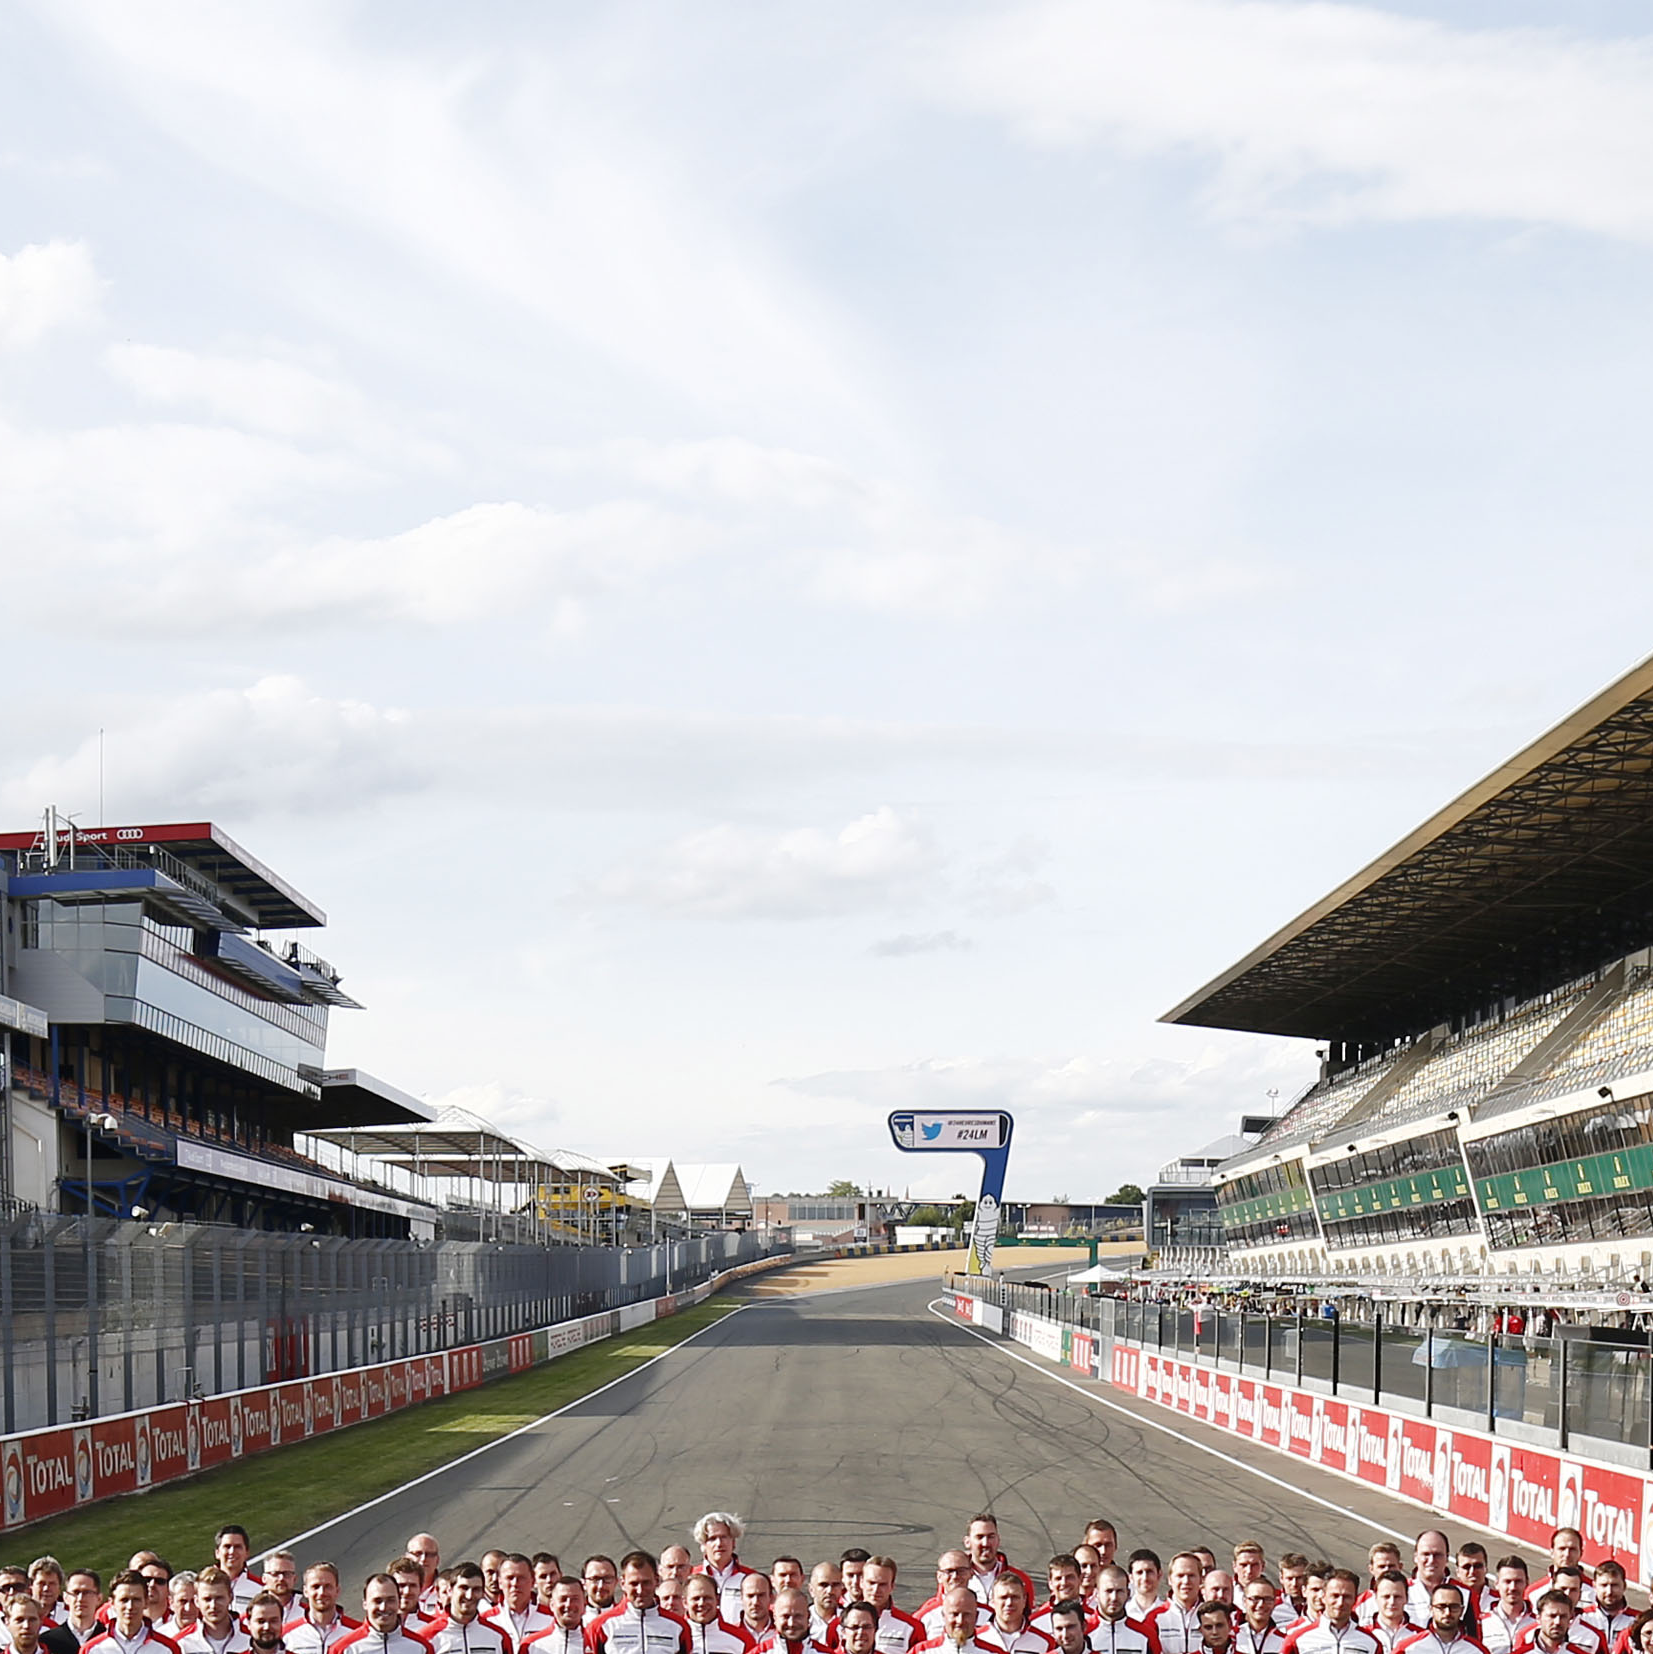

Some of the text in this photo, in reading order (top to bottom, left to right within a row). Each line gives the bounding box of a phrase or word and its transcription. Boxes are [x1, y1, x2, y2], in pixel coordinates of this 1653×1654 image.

[957, 1130, 987, 1140] #24LM
[201, 1416, 230, 1447] TOTAL
[244, 1407, 269, 1436] TOTAL
[96, 1440, 135, 1478] TOTAL
[152, 1427, 186, 1462] TOTAL
[1360, 1425, 1386, 1467] TOTAL
[1402, 1436, 1432, 1483] TOTAL
[27, 1454, 73, 1495] TOTAL
[1452, 1450, 1489, 1501] TOTAL
[1511, 1468, 1557, 1528] TOTAL
[1581, 1489, 1639, 1554] TOTAL
